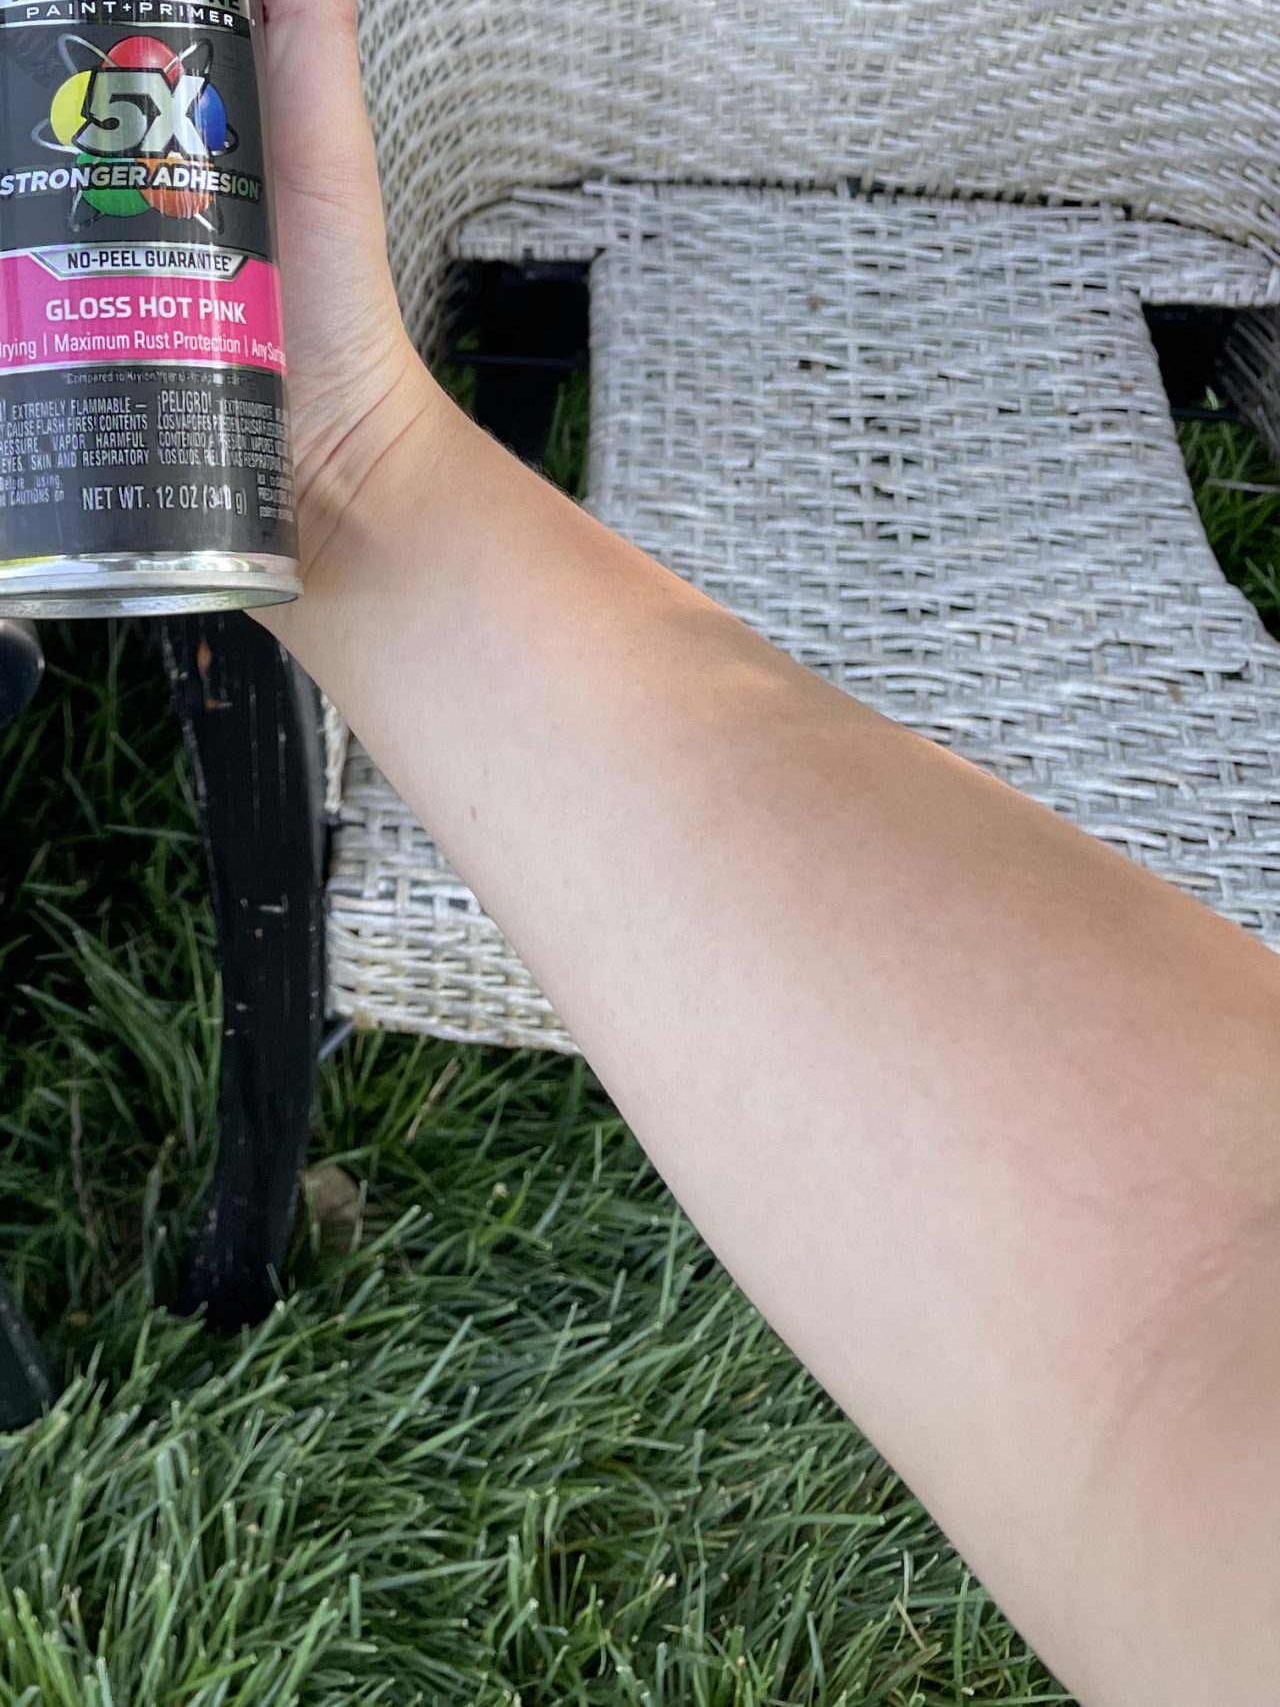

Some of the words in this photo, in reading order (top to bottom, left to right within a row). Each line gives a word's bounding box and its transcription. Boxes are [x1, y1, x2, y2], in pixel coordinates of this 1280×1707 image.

[26, 0, 235, 28] PAINT+PRIMER
[74, 70, 210, 158] 5X
[0, 165, 147, 196] STRONGER
[153, 166, 260, 199] ADHESION
[67, 250, 141, 269] NO-PEEL
[145, 250, 231, 272] GUARANTEE
[45, 298, 132, 323] GLOSS
[138, 296, 193, 320] HOT
[199, 299, 248, 325] PINK
[55, 332, 130, 354] Maximum
[134, 331, 170, 350] Rust
[173, 331, 241, 355] Protection
[252, 337, 267, 363] Any
[13, 400, 67, 420] EXTREMELY
[70, 397, 131, 415] FLAMMABLE
[7, 421, 35, 438] CAUSE
[36, 418, 64, 435] FLASH
[67, 416, 96, 433] FIRES!
[99, 414, 148, 431] CONTENTS
[158, 414, 176, 430] LOS
[52, 434, 86, 451] VAPOR
[31, 454, 51, 471] SKIN
[57, 452, 77, 468] AND
[82, 449, 150, 467] RESPIRATORY
[10, 488, 50, 506] CAUTIONS
[83, 487, 114, 510] NET
[118, 485, 150, 510] WT.
[156, 486, 175, 509] 12
[180, 485, 199, 509] OZ
[236, 488, 247, 516] g)
